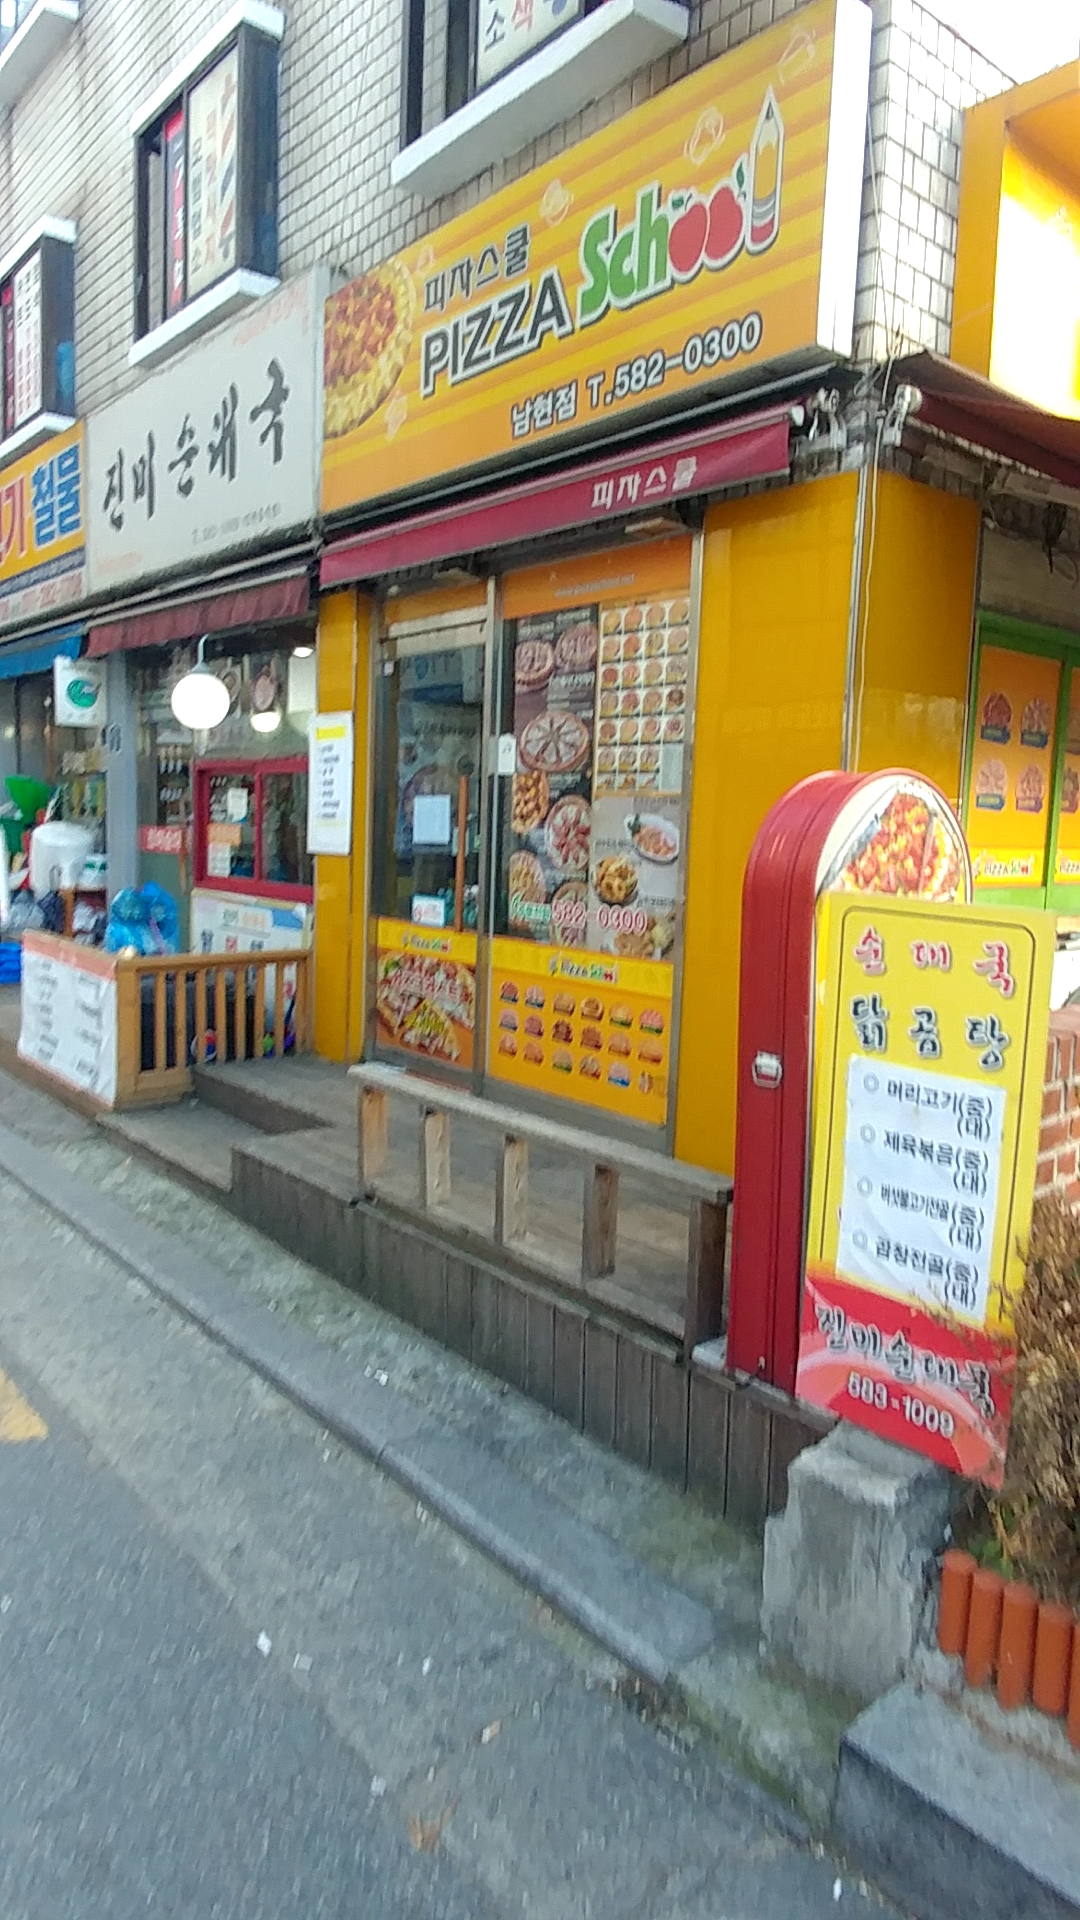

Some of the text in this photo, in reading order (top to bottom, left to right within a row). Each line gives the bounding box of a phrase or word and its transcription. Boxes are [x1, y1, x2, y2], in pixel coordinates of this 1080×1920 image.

[424, 223, 530, 313] 피자스쿨
[421, 266, 575, 399] PIZZA
[511, 380, 578, 439] 남현점
[31, 443, 82, 548] 철물
[591, 456, 698, 510] 피자스쿨
